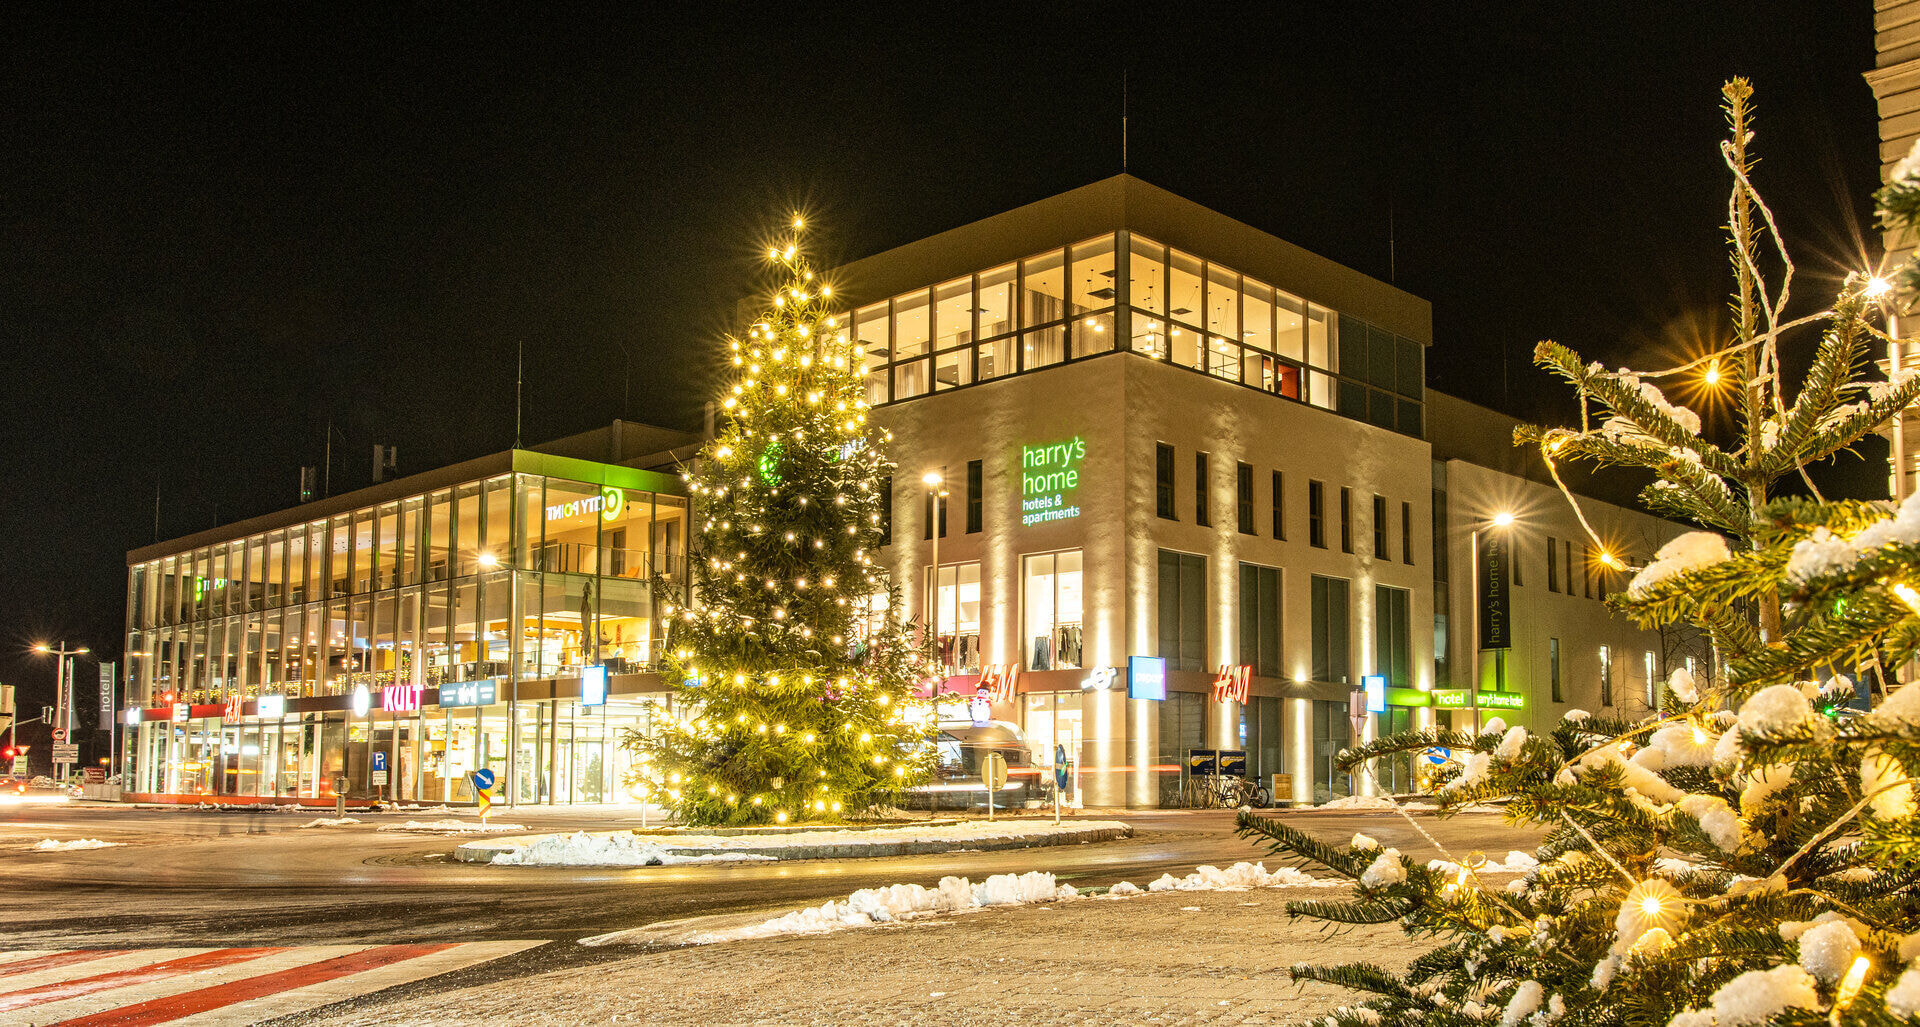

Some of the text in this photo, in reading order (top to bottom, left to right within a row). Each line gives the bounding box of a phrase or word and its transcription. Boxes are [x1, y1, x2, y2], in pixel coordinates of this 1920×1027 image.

[1023, 436, 1086, 468] harry's
[1023, 470, 1078, 495] home
[1022, 494, 1063, 511] hotels &
[1022, 505, 1080, 527] apartments
[1487, 560, 1499, 598] home
[1488, 601, 1502, 644] harry's
[100, 679, 111, 712] hotel
[383, 685, 424, 712] KULT
[1213, 664, 1251, 706] H&M
[1438, 692, 1464, 705] hotel
[1493, 694, 1509, 706] home
[1510, 695, 1523, 706] hotel
